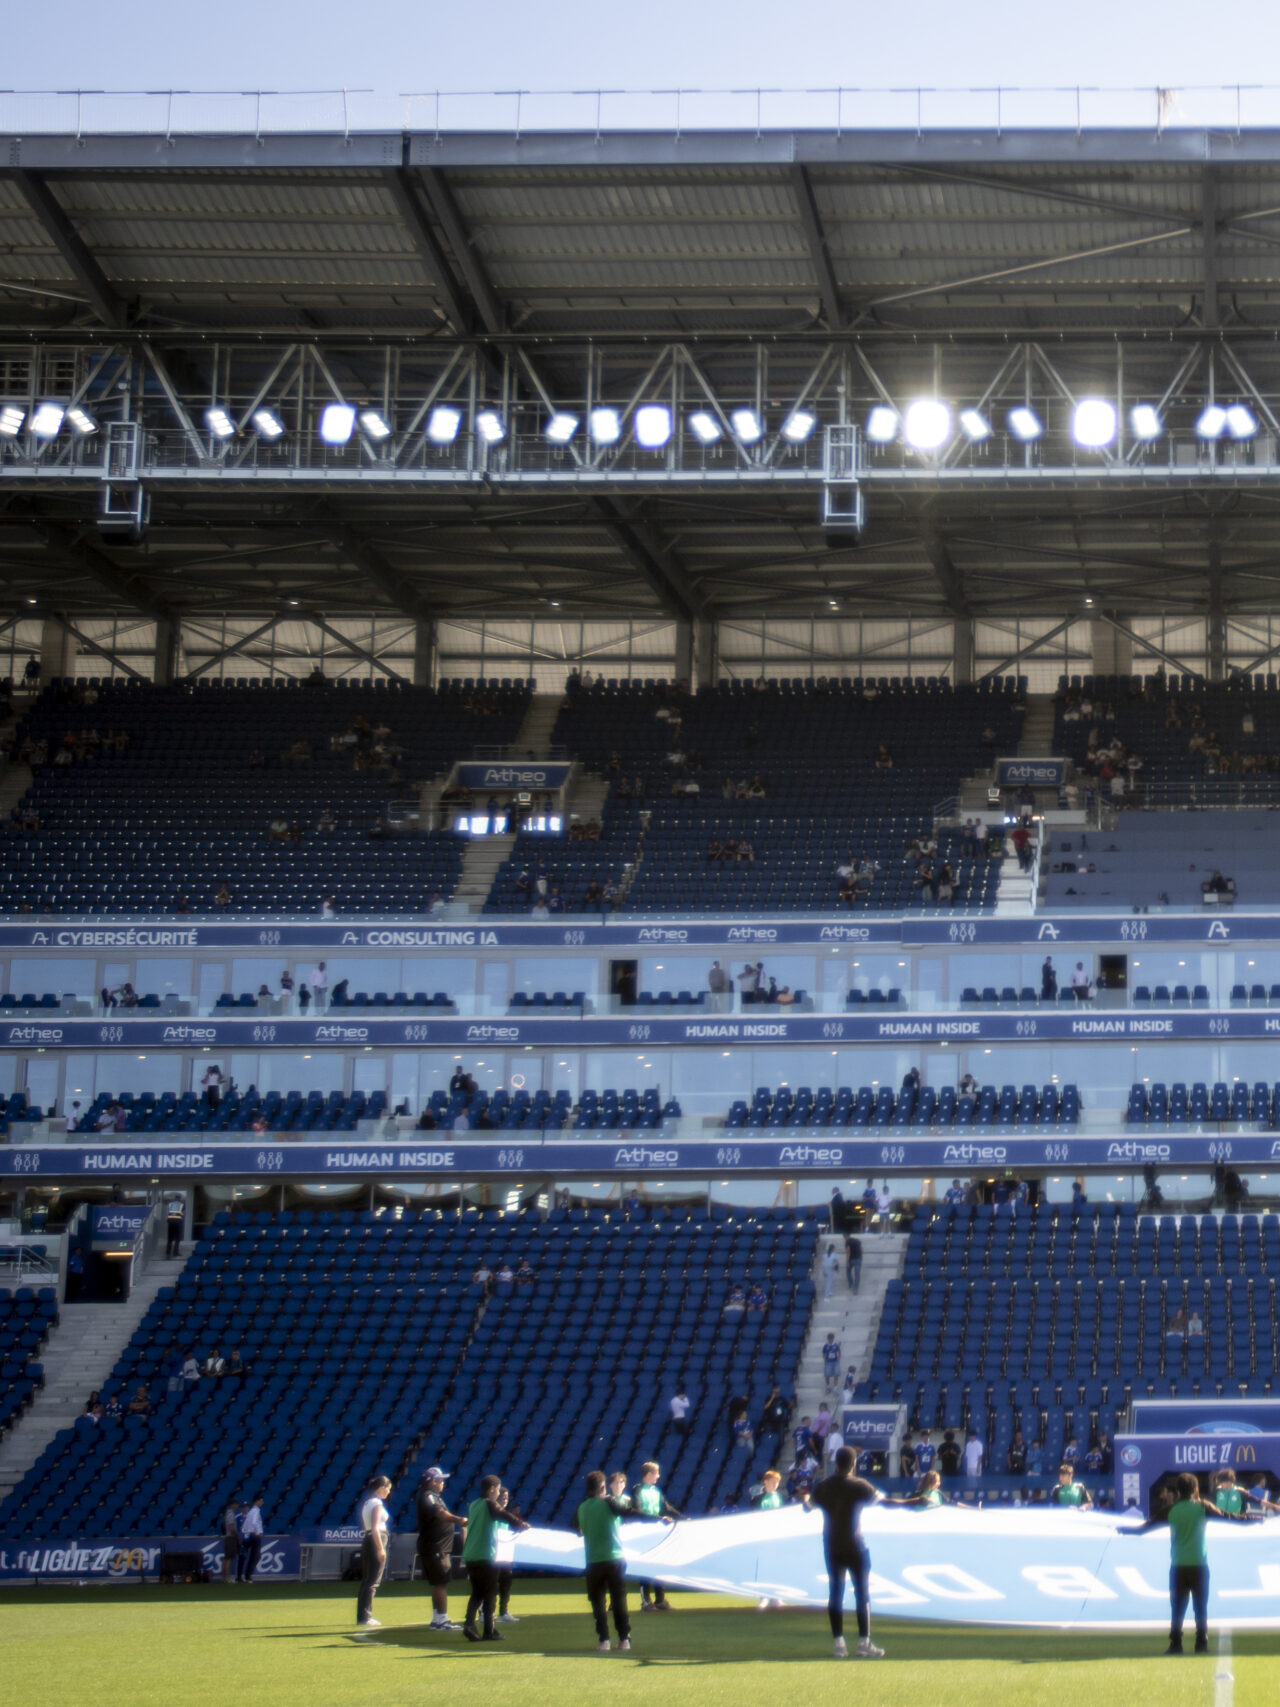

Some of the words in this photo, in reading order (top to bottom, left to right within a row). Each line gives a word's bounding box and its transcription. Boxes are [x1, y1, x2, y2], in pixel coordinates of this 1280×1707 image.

[57, 927, 198, 946] CYBERSÉCURITÉ
[639, 928, 688, 939] Atheo
[728, 927, 777, 938] Atheo
[820, 926, 869, 937] Atheo
[367, 931, 475, 946] CONSULTING
[479, 931, 498, 945] IA
[163, 1026, 216, 1038] Atheo
[316, 1026, 368, 1038] Atheo
[467, 1025, 520, 1037] Atheo
[686, 1025, 739, 1037] HUMAN
[743, 1024, 787, 1036] INSIDE
[880, 1023, 932, 1034] HUMAN
[937, 1022, 980, 1034] INSIDE
[1073, 1021, 1125, 1032] HUMAN
[1130, 1020, 1173, 1032] INSIDE
[9, 1027, 63, 1039] Atheo
[615, 1148, 678, 1162] Atheo
[779, 1146, 842, 1160] Atheo
[944, 1144, 1006, 1158] Atheo
[1107, 1142, 1170, 1156] Atheo
[84, 1155, 151, 1169] HUMAN
[158, 1154, 213, 1168] INSIDE
[327, 1153, 393, 1167] HUMAN
[399, 1152, 454, 1166] INSIDE
[97, 1215, 145, 1228] Athe
[1175, 1445, 1217, 1464] LIGUE
[325, 1530, 366, 1538] RACING
